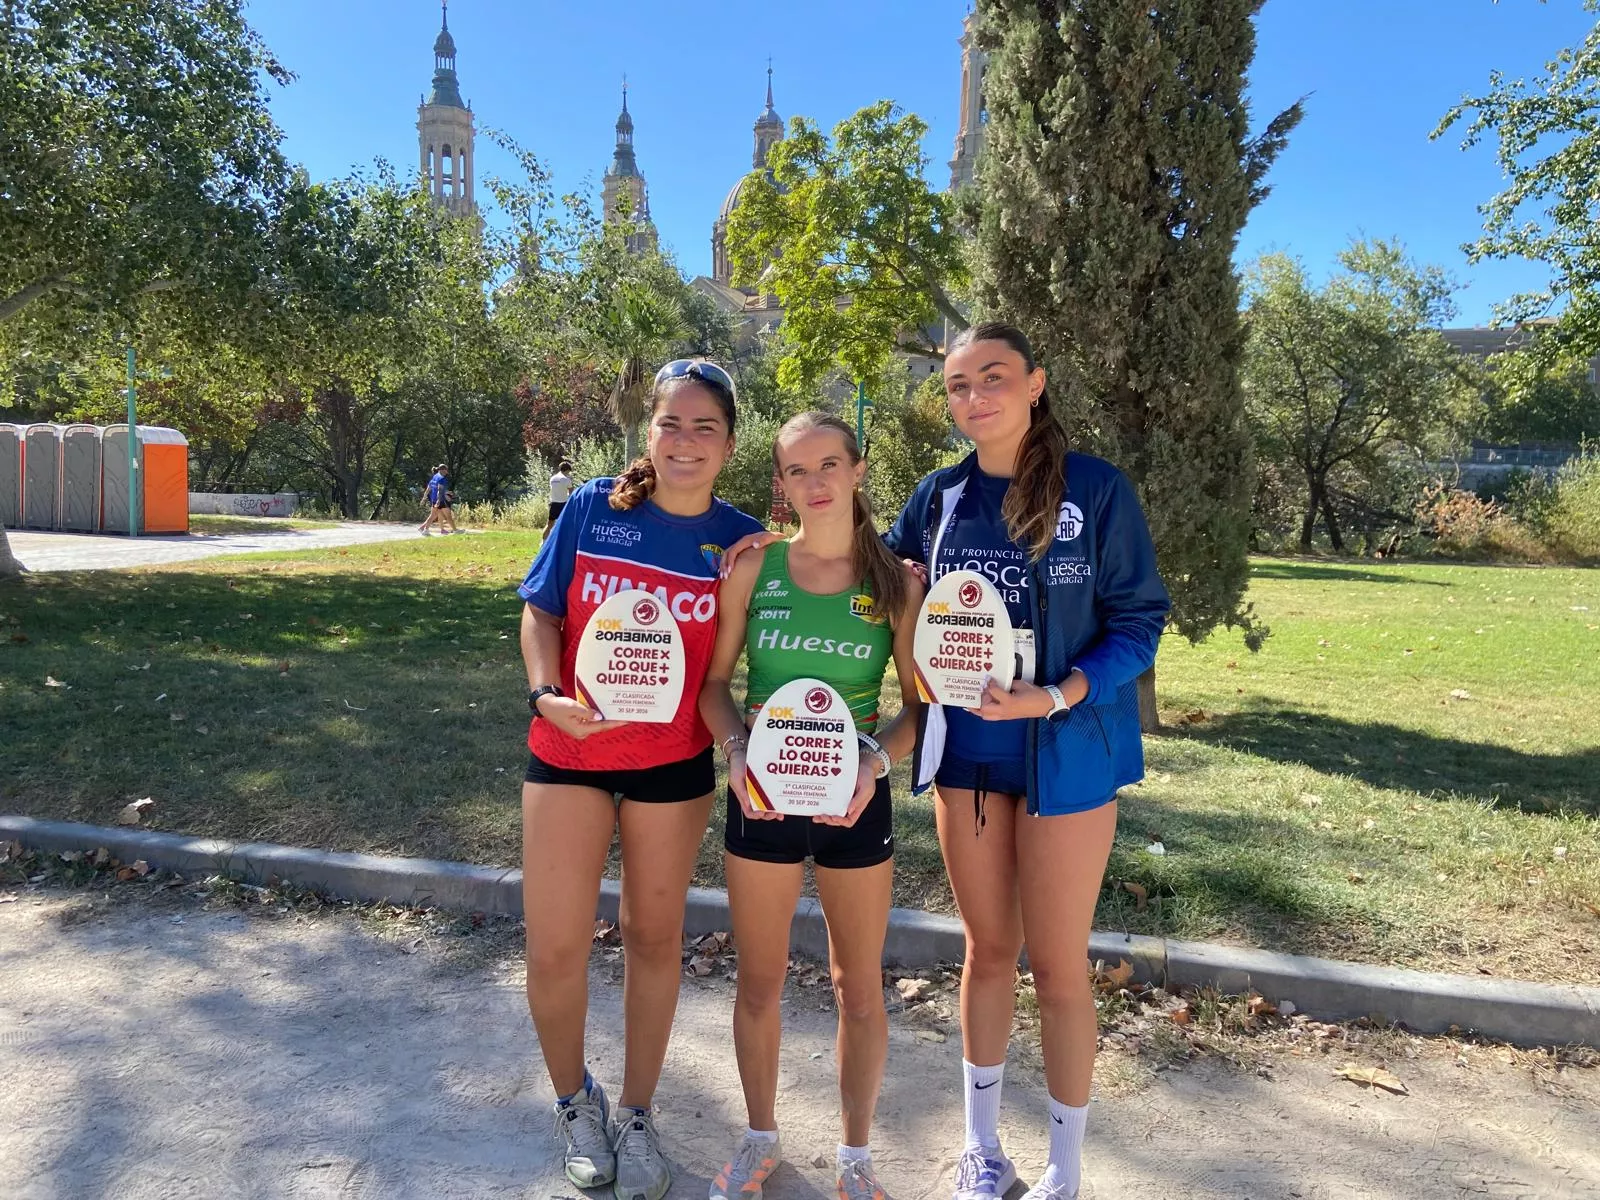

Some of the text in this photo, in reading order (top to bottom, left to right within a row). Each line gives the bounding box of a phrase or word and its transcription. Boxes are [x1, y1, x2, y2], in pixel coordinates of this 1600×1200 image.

[1049, 562, 1092, 577] uesca
[928, 602, 949, 613] 10K
[596, 619, 622, 630] 10K
[758, 629, 872, 659] Huesca
[943, 631, 982, 644] CORRE
[614, 647, 658, 659] CORRE
[940, 644, 955, 655] LO
[957, 645, 982, 658] QUE
[608, 660, 626, 671] LO
[629, 660, 657, 672] QUE
[930, 657, 982, 672] QUIERAS
[596, 673, 657, 686] QUIERAS
[768, 707, 794, 719] 10K
[785, 736, 831, 749] CORRE
[779, 749, 798, 760] LO
[800, 750, 829, 763] QUE
[767, 762, 828, 777] QUIERAS
